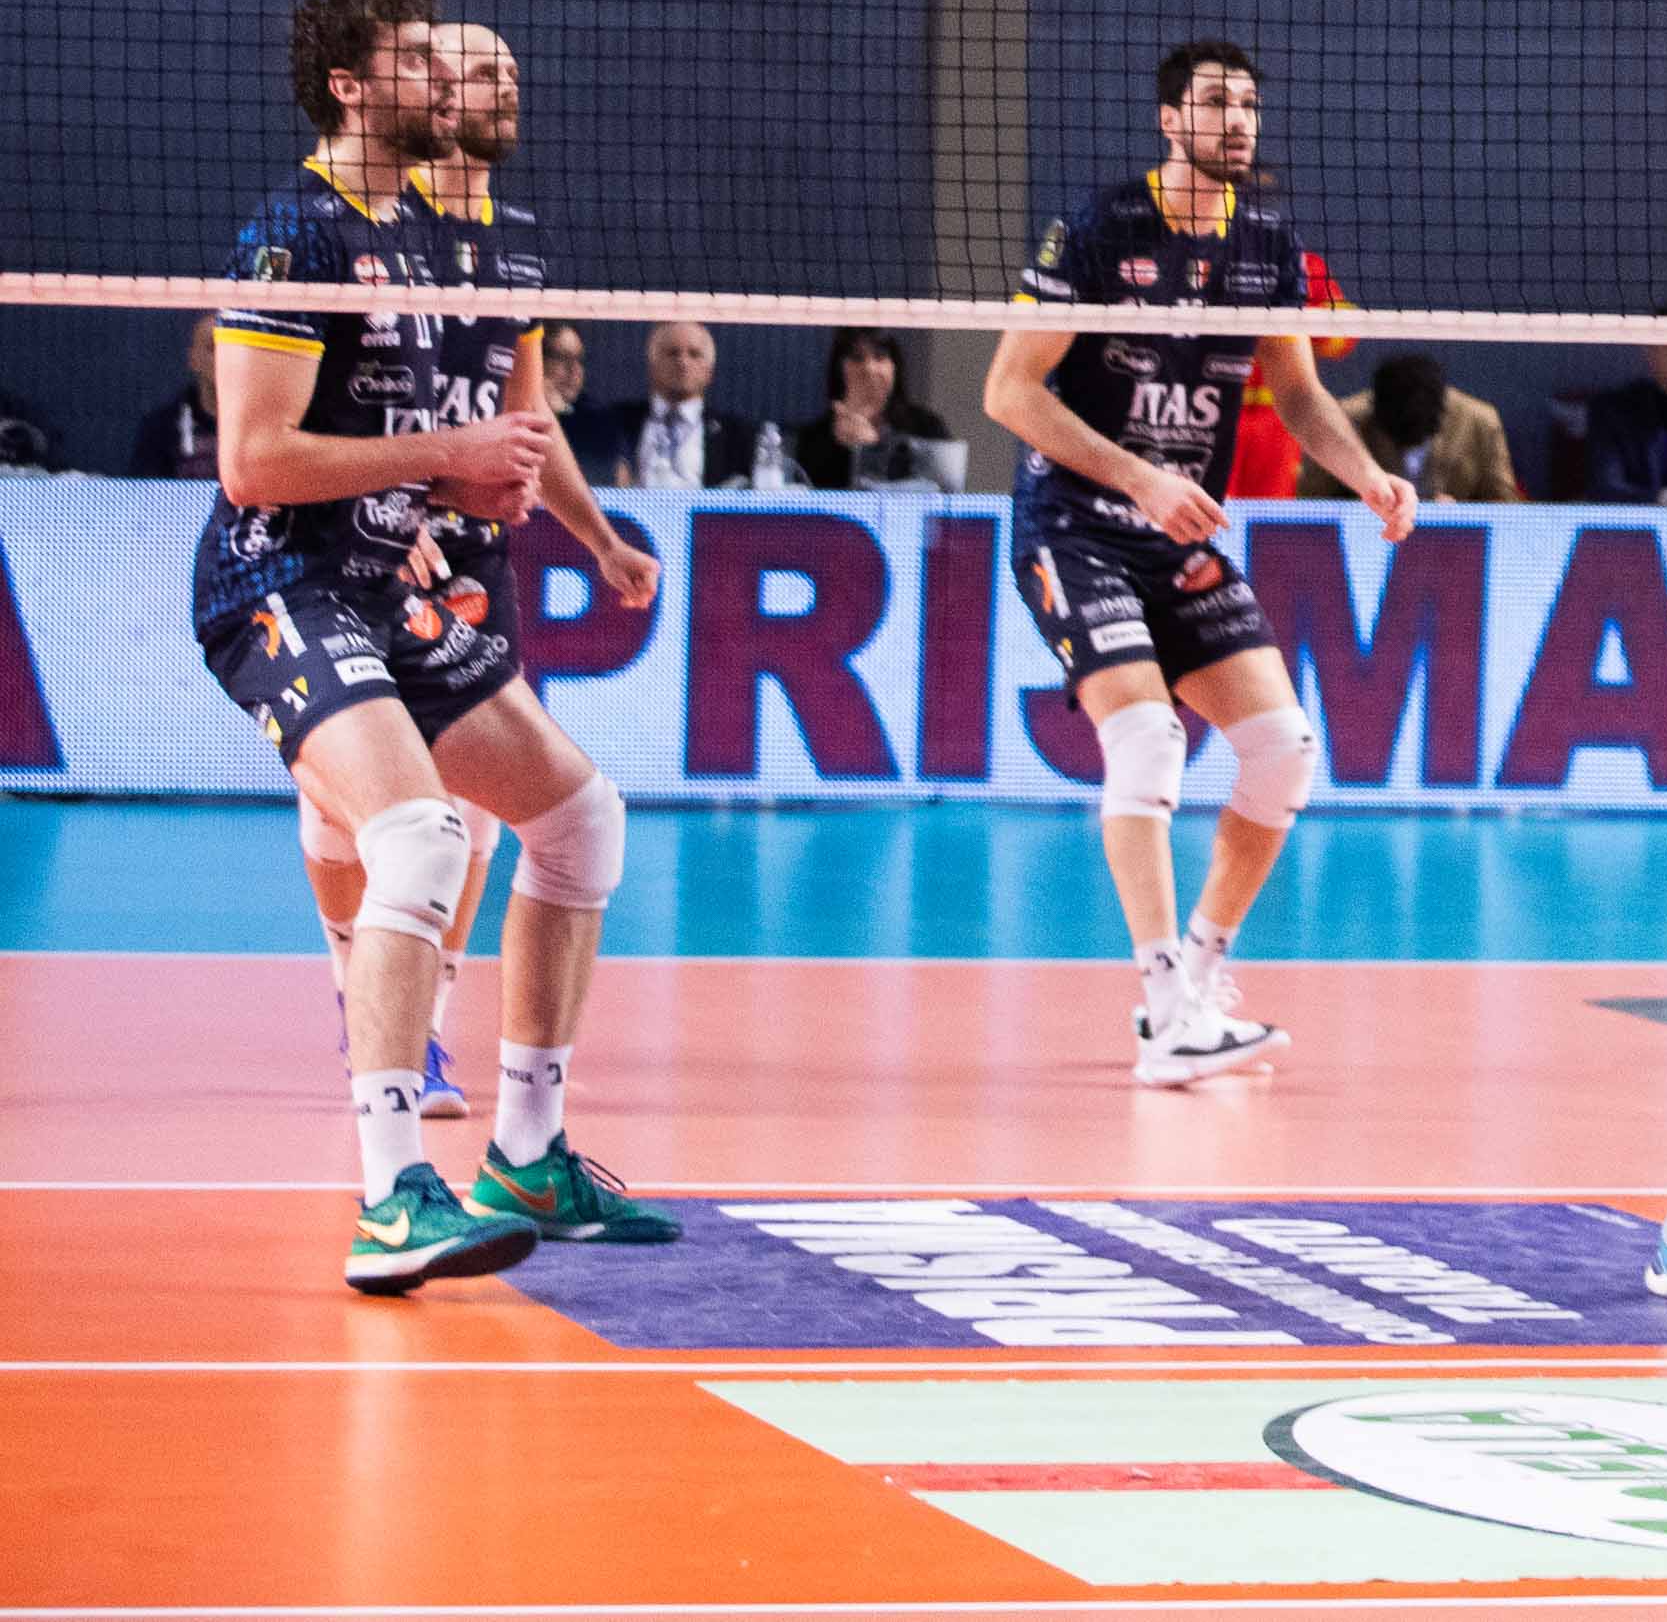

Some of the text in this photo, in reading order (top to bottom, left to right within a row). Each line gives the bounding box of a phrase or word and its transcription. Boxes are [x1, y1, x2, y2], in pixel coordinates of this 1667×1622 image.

[1127, 381, 1223, 429] ITAS
[716, 1199, 1305, 1346] PRISMA
[1207, 1216, 1584, 1324] TARANTO
